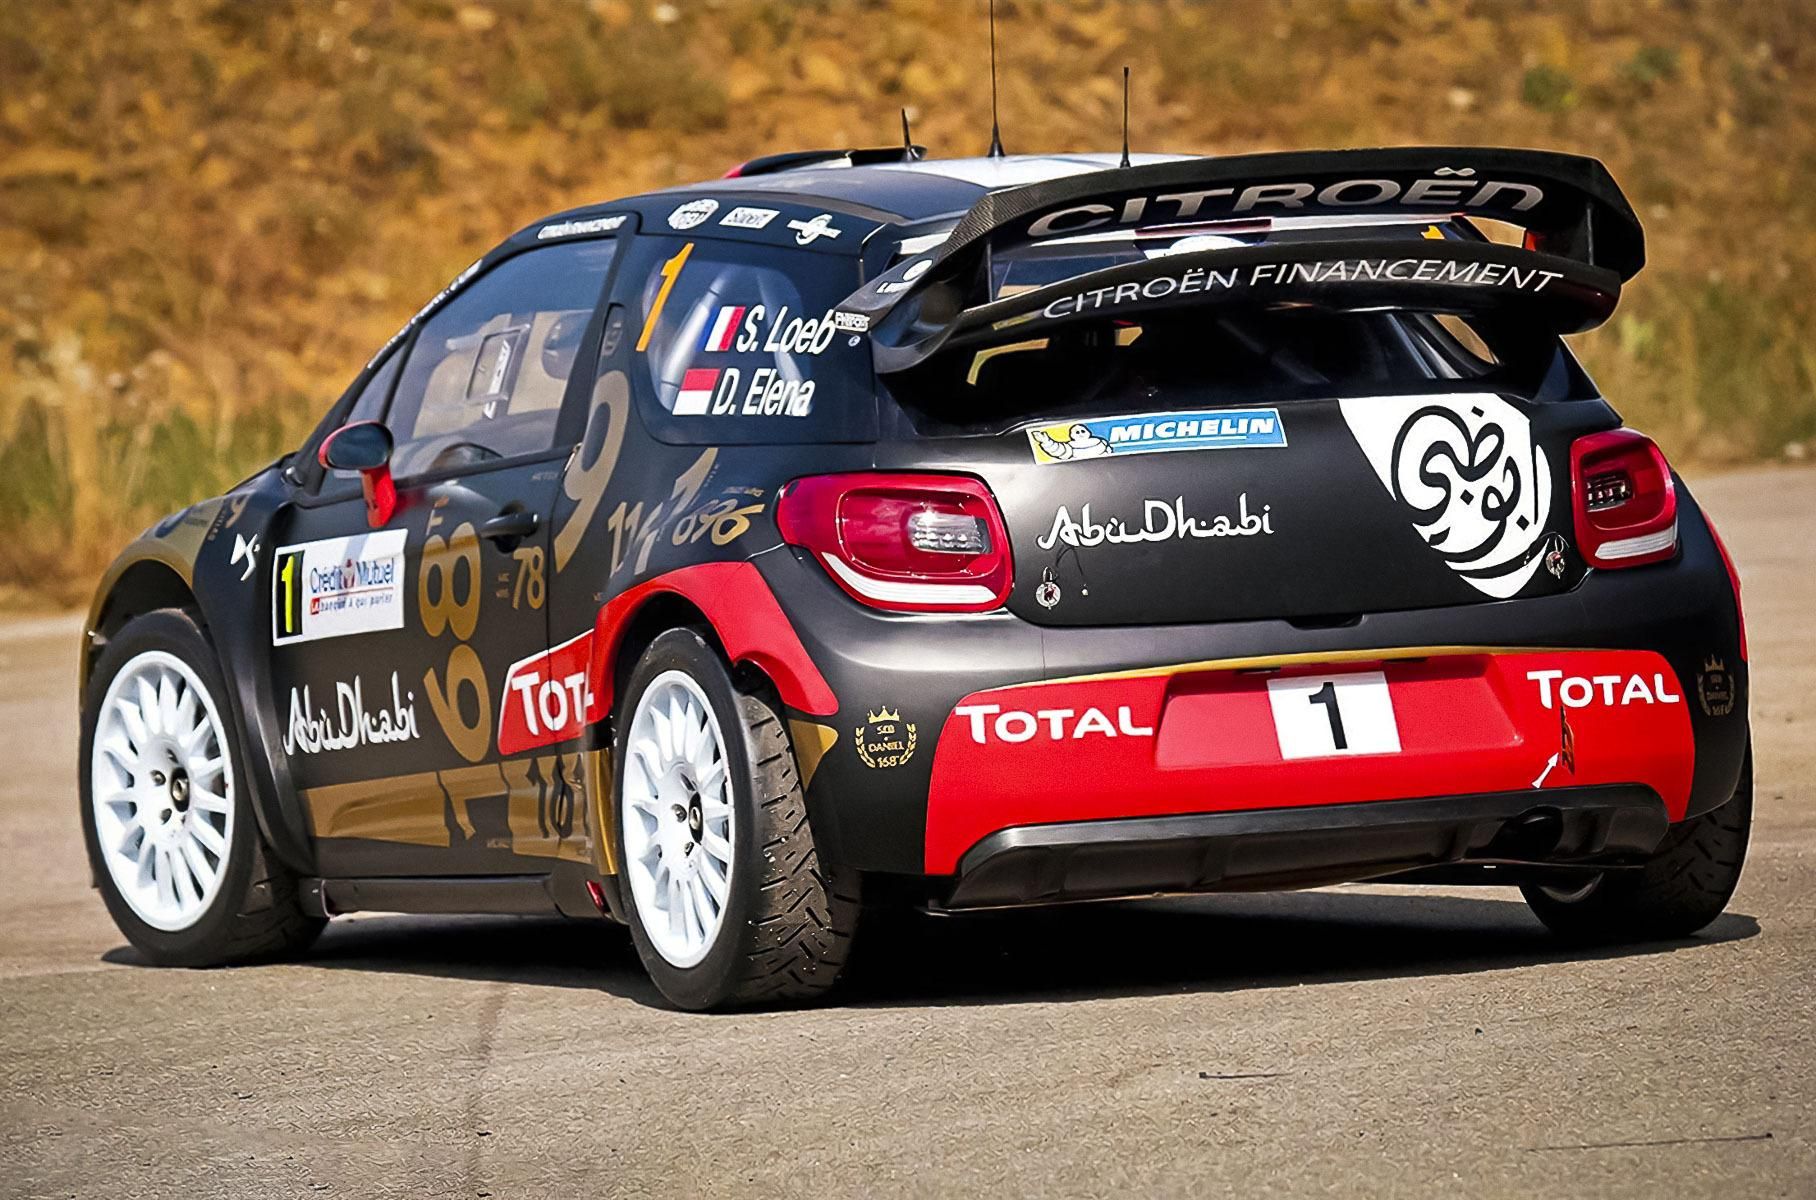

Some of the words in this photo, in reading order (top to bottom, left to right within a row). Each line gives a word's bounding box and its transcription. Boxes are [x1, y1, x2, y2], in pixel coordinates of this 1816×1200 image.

[635, 243, 694, 351] 1
[1043, 268, 1238, 319] CITROËN
[1250, 259, 1563, 293] FINANCEMENT
[736, 305, 764, 353] S.
[763, 306, 834, 355] Loeb
[711, 368, 735, 415] D.
[742, 368, 815, 417] Elena
[1109, 417, 1274, 443] MICHELIN
[281, 555, 295, 633] 1
[1527, 670, 1679, 709] TOTAL
[956, 704, 1152, 744] TOTAL
[1308, 682, 1347, 750] 1
